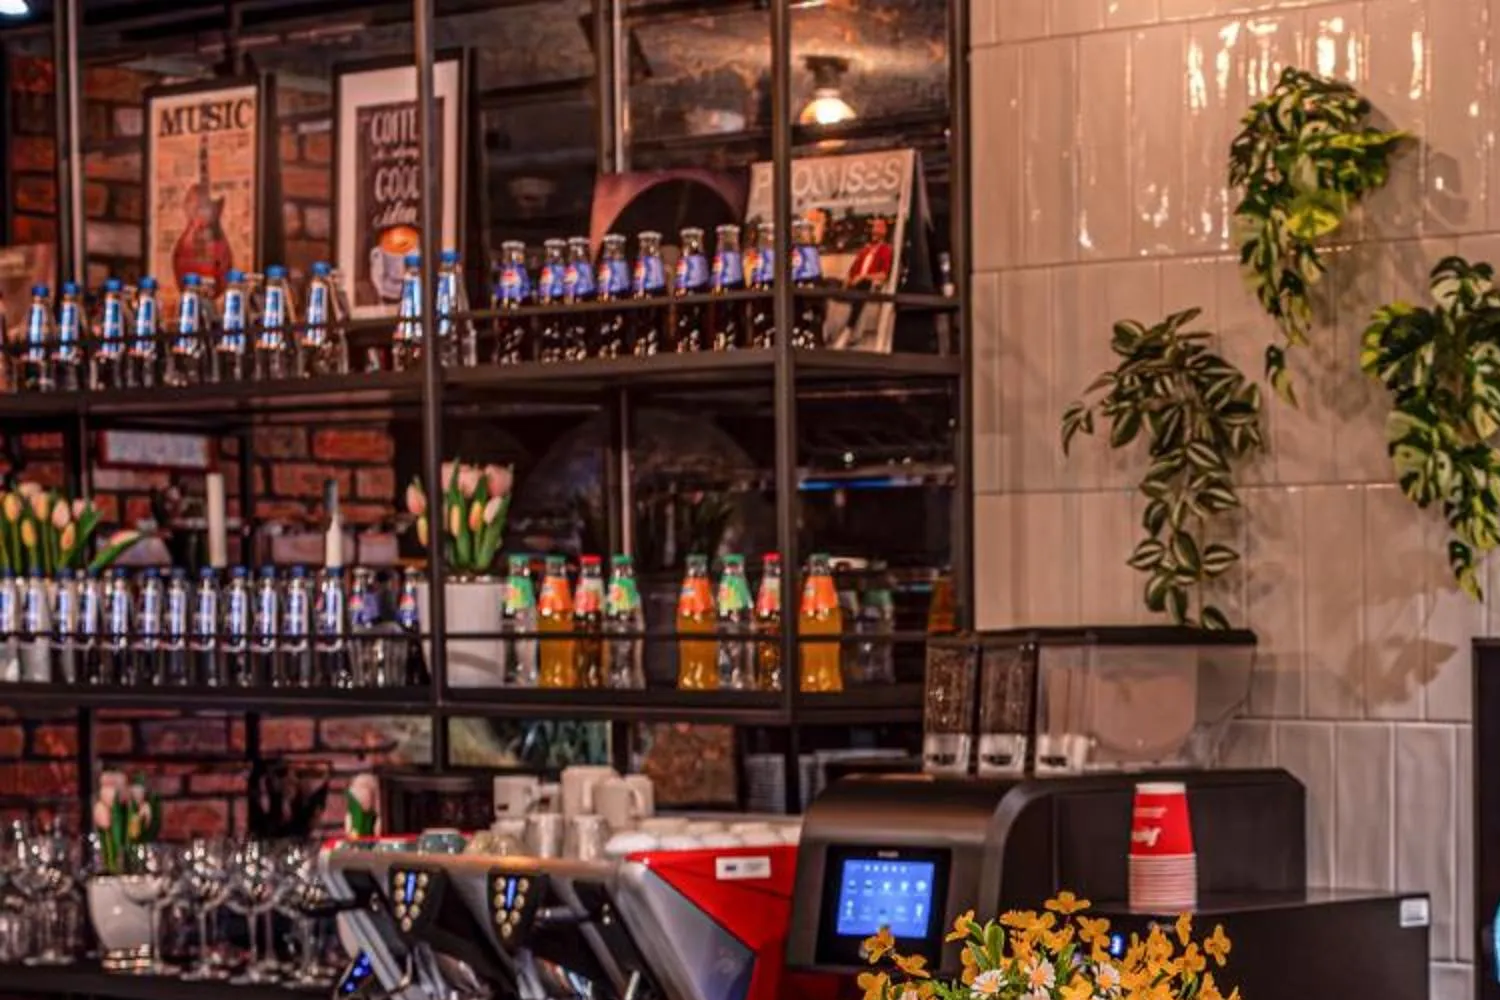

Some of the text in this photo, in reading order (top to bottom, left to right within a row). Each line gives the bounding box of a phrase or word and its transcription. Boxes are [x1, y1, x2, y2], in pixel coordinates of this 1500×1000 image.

[158, 98, 254, 138] MUSIC
[371, 108, 420, 145] COFFE
[753, 157, 902, 200] POMISES
